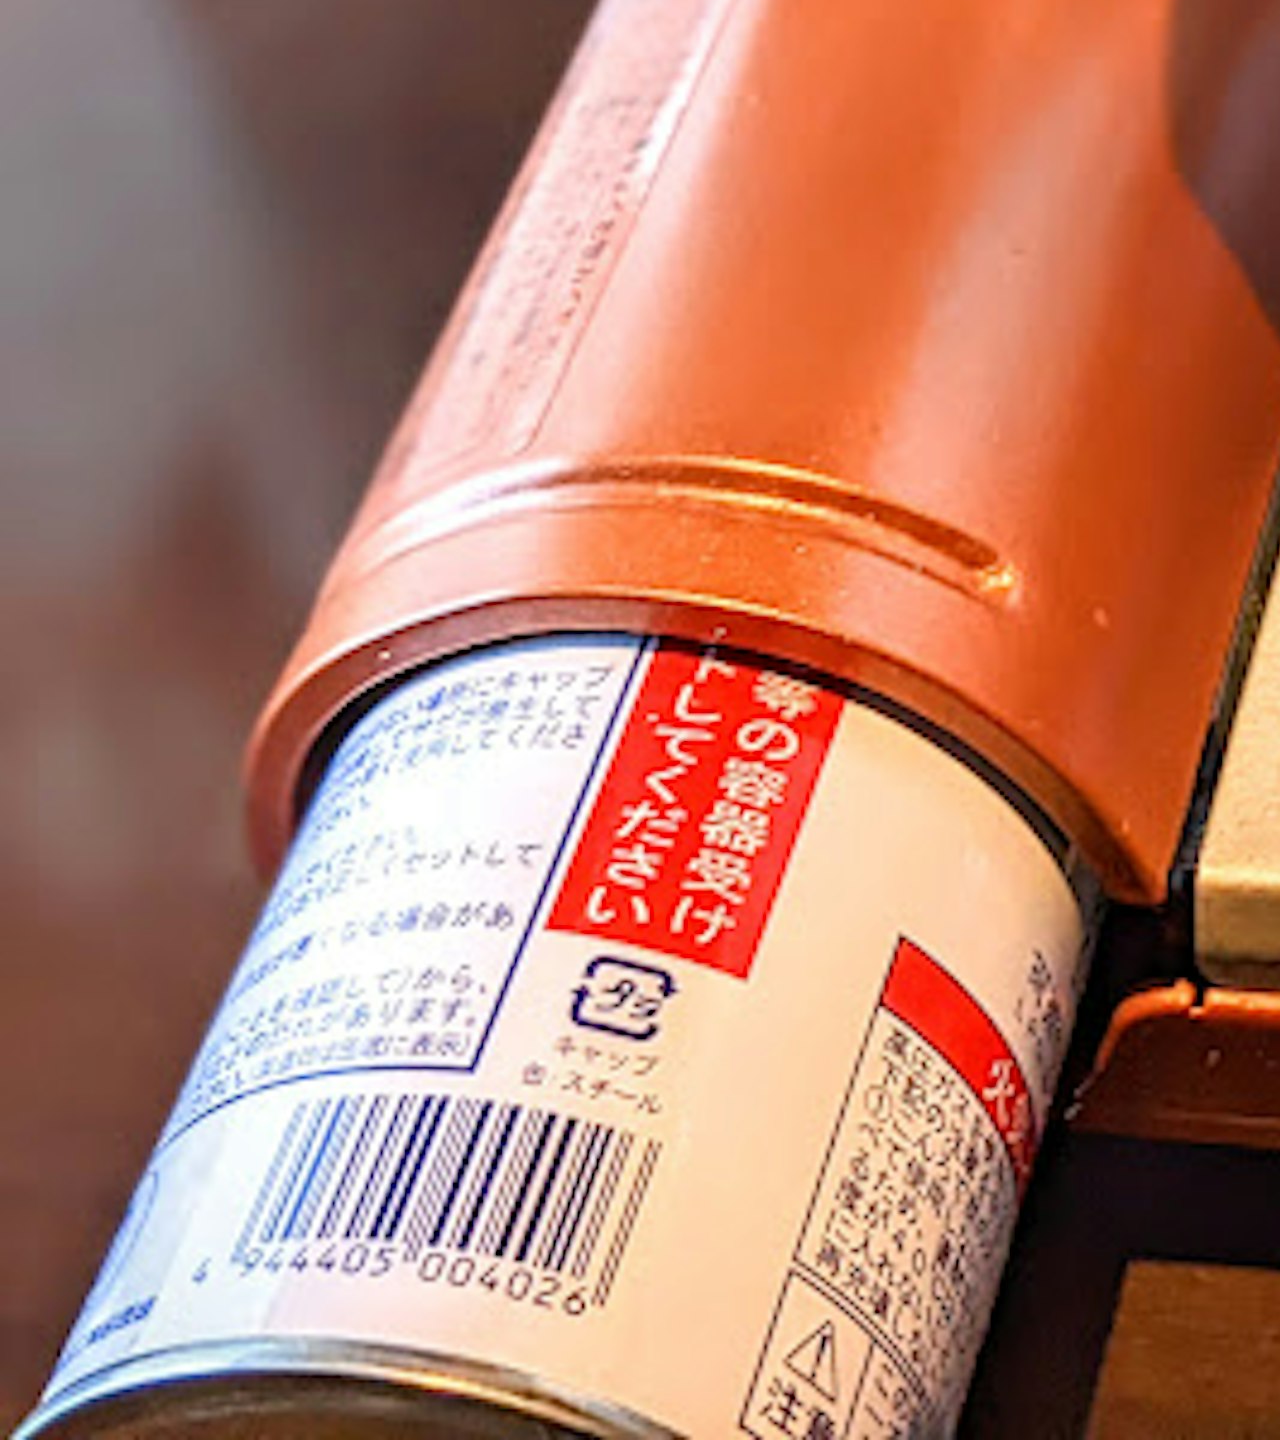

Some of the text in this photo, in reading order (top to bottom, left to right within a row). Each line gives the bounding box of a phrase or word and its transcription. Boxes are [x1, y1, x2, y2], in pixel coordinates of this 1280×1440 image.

[556, 1035, 659, 1076] キャップ
[239, 1241, 397, 1278] 944405
[416, 1250, 590, 1317] 004026
